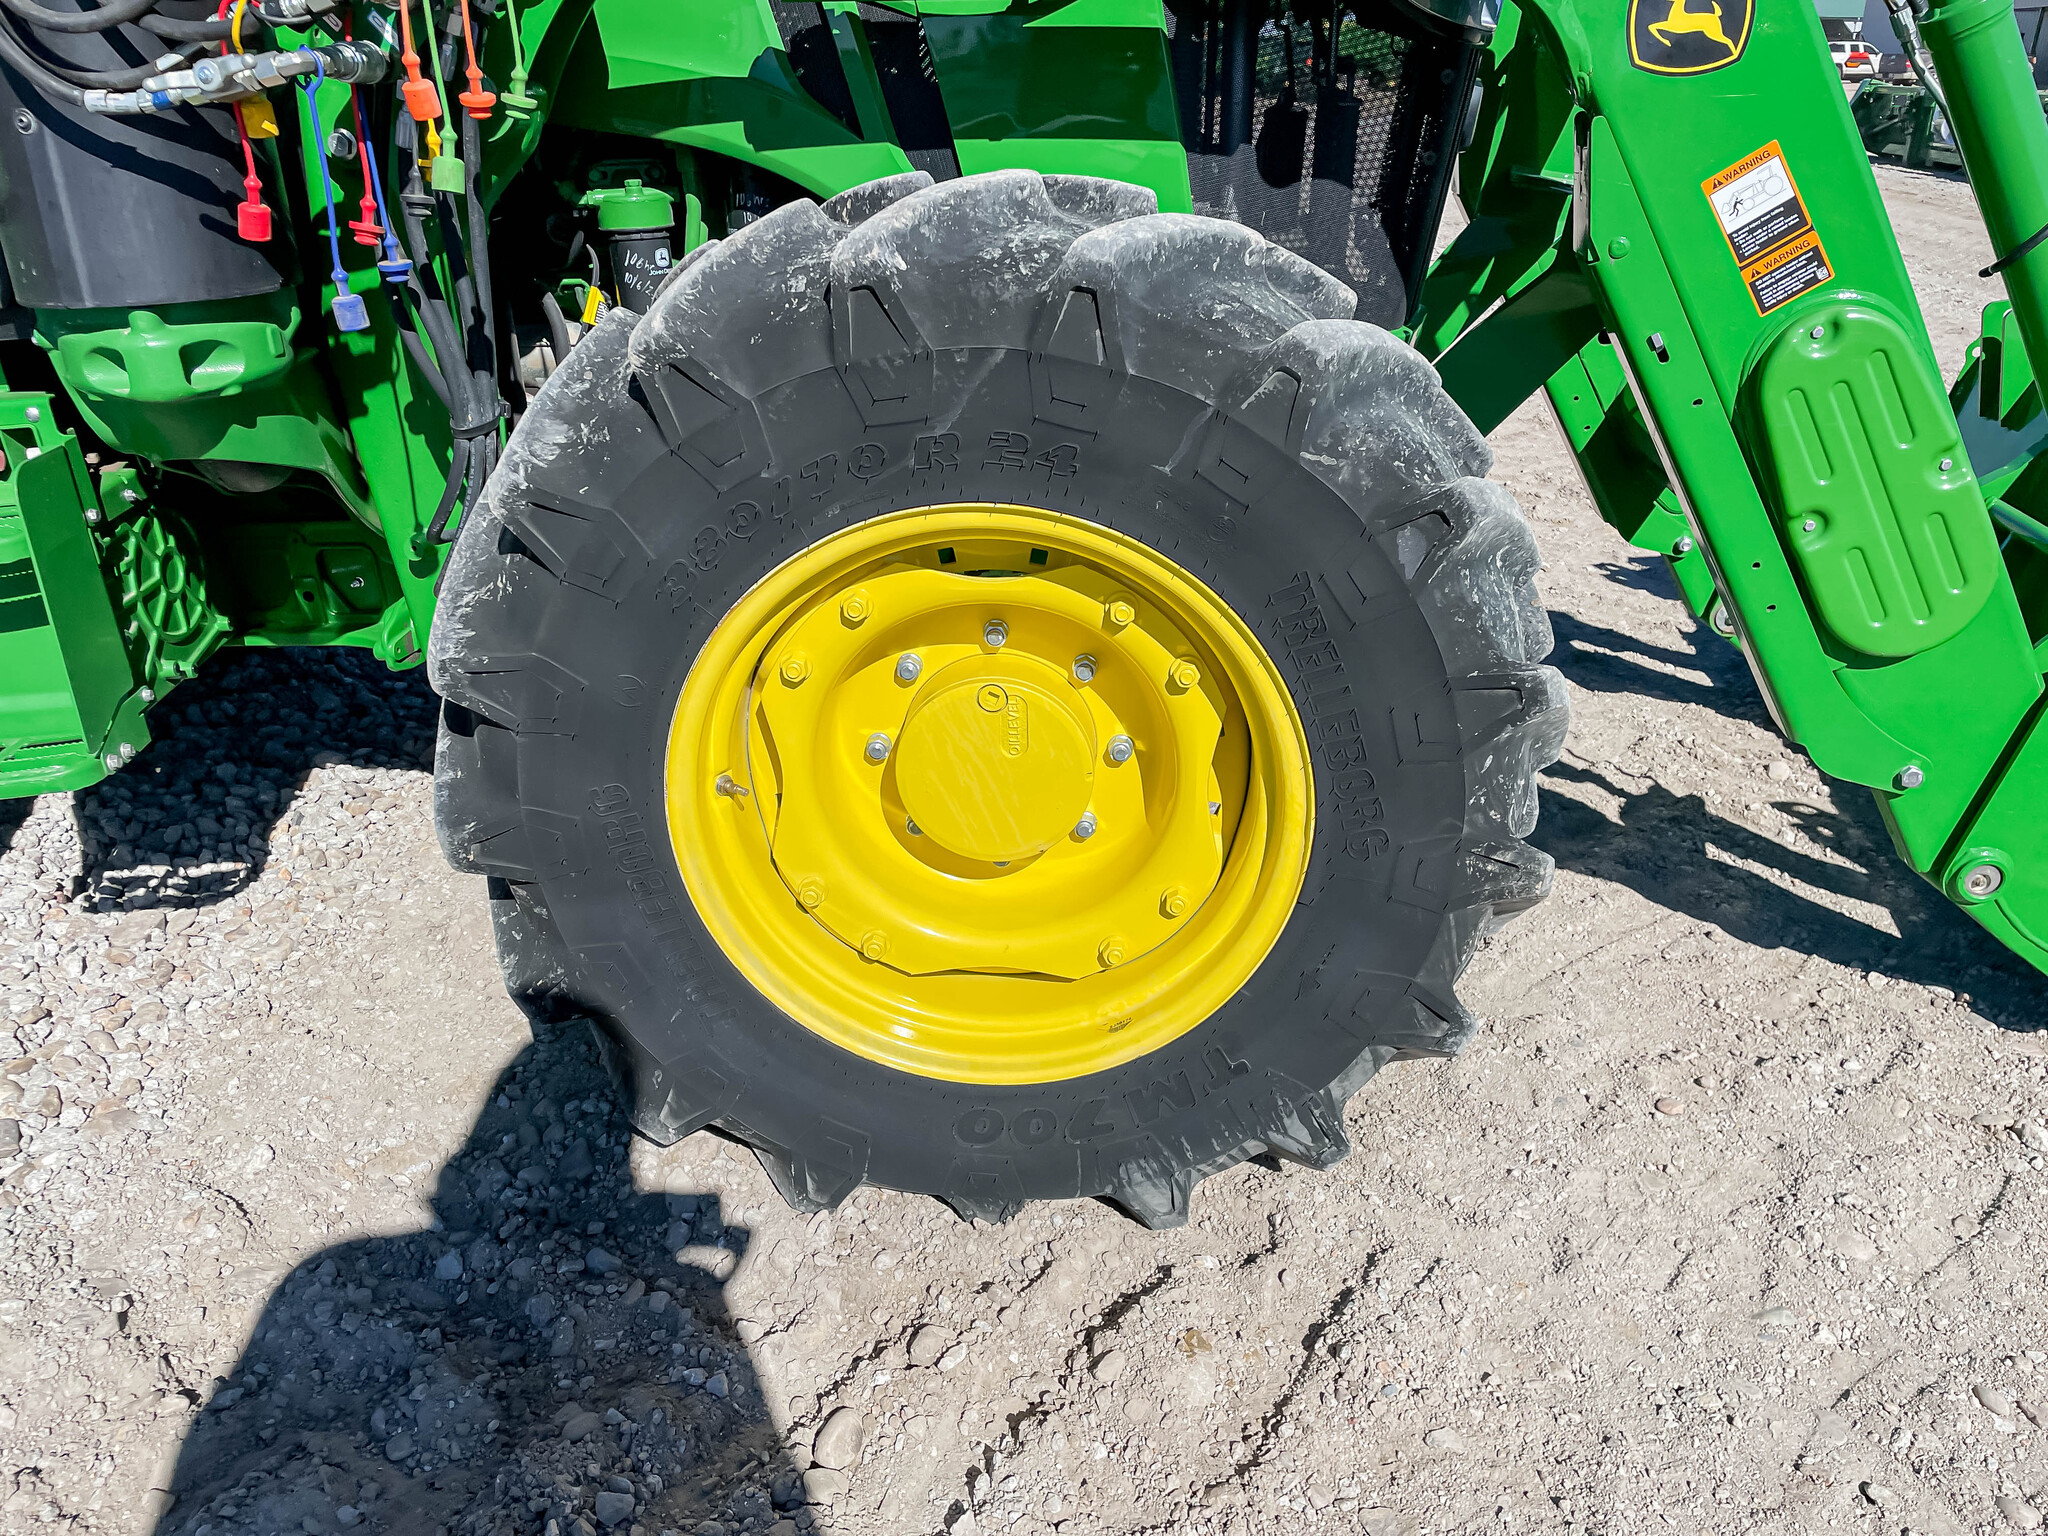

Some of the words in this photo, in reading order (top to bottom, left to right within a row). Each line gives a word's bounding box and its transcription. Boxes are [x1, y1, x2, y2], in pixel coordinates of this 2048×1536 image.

[1723, 150, 1770, 182] WARNING
[1763, 240, 1811, 270] WARNING
[912, 432, 962, 472] R
[982, 431, 1081, 477] 24
[1266, 569, 1391, 861] TRELLEBORG
